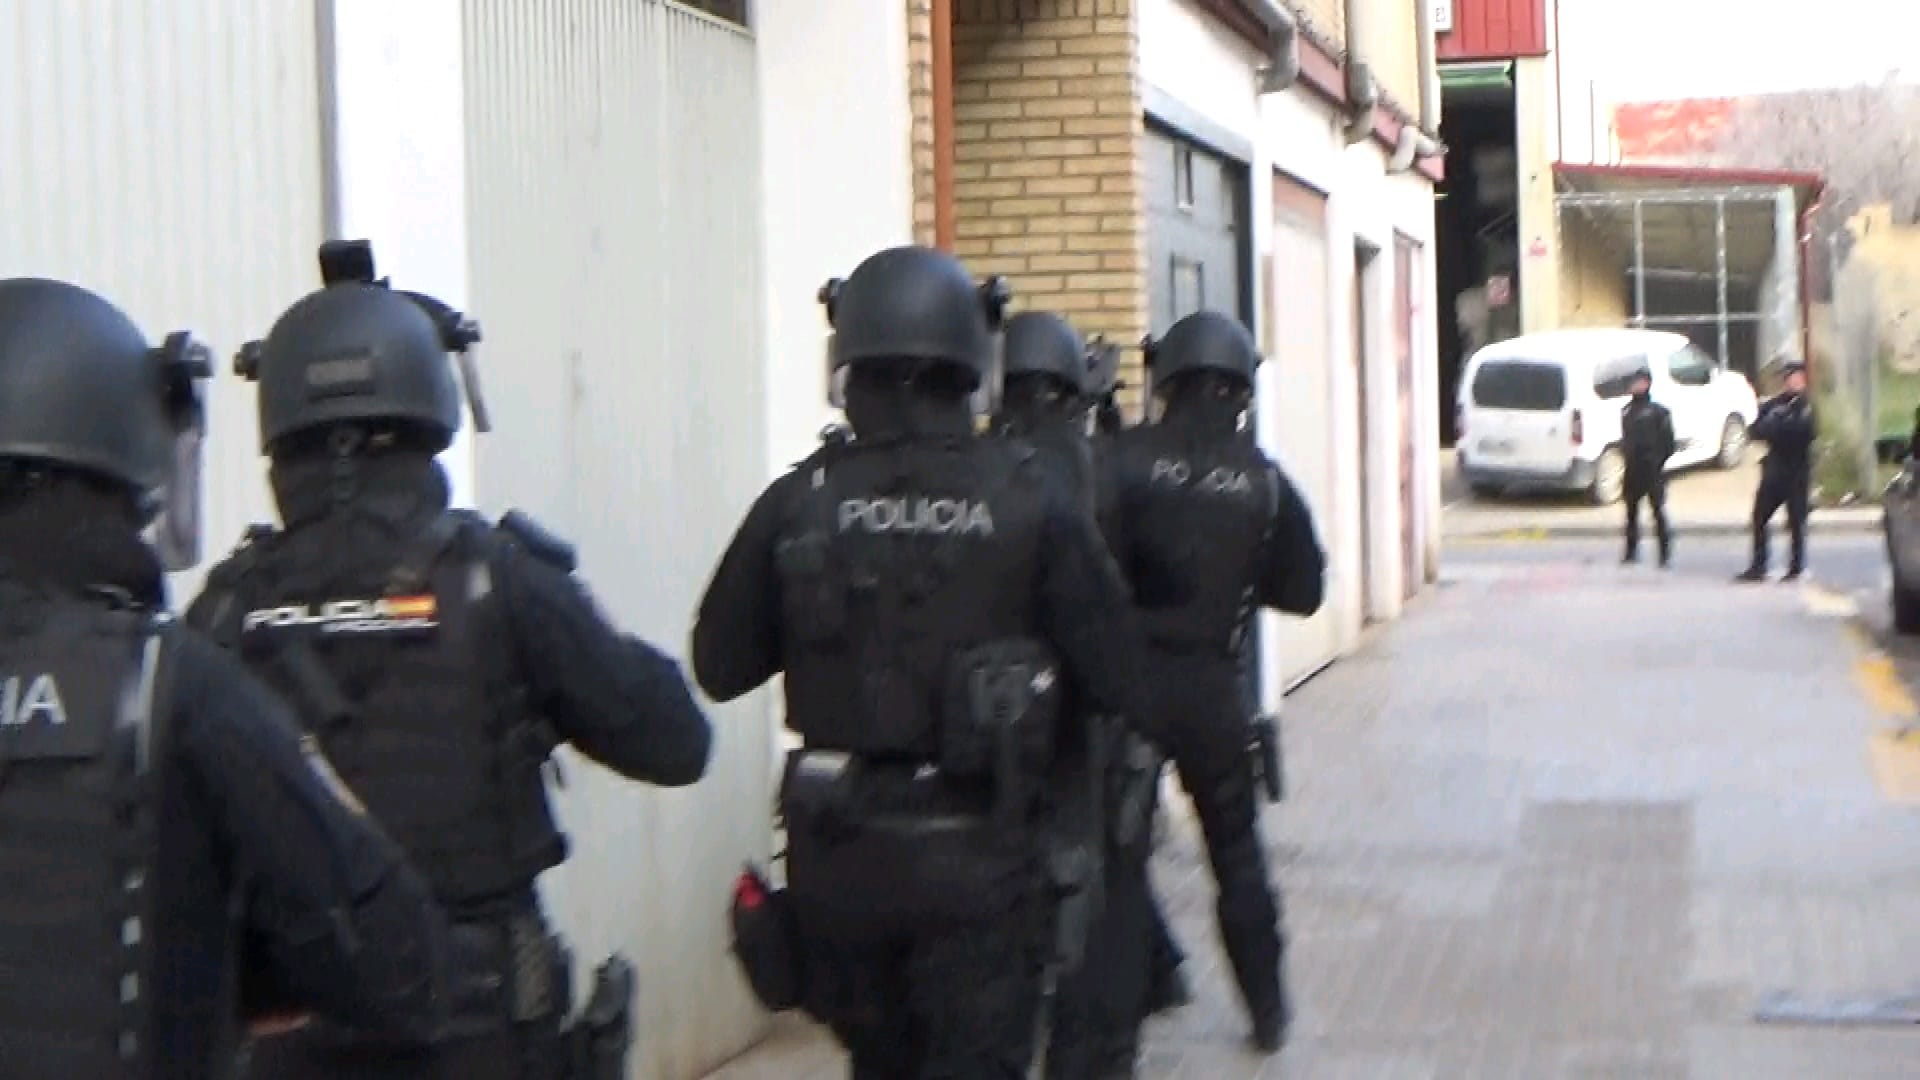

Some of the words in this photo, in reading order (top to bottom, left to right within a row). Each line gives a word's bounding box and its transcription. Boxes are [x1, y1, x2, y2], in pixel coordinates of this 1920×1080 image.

[1150, 457, 1251, 494] POCIA
[838, 497, 995, 537] POLICIA
[0, 672, 67, 726] IA
